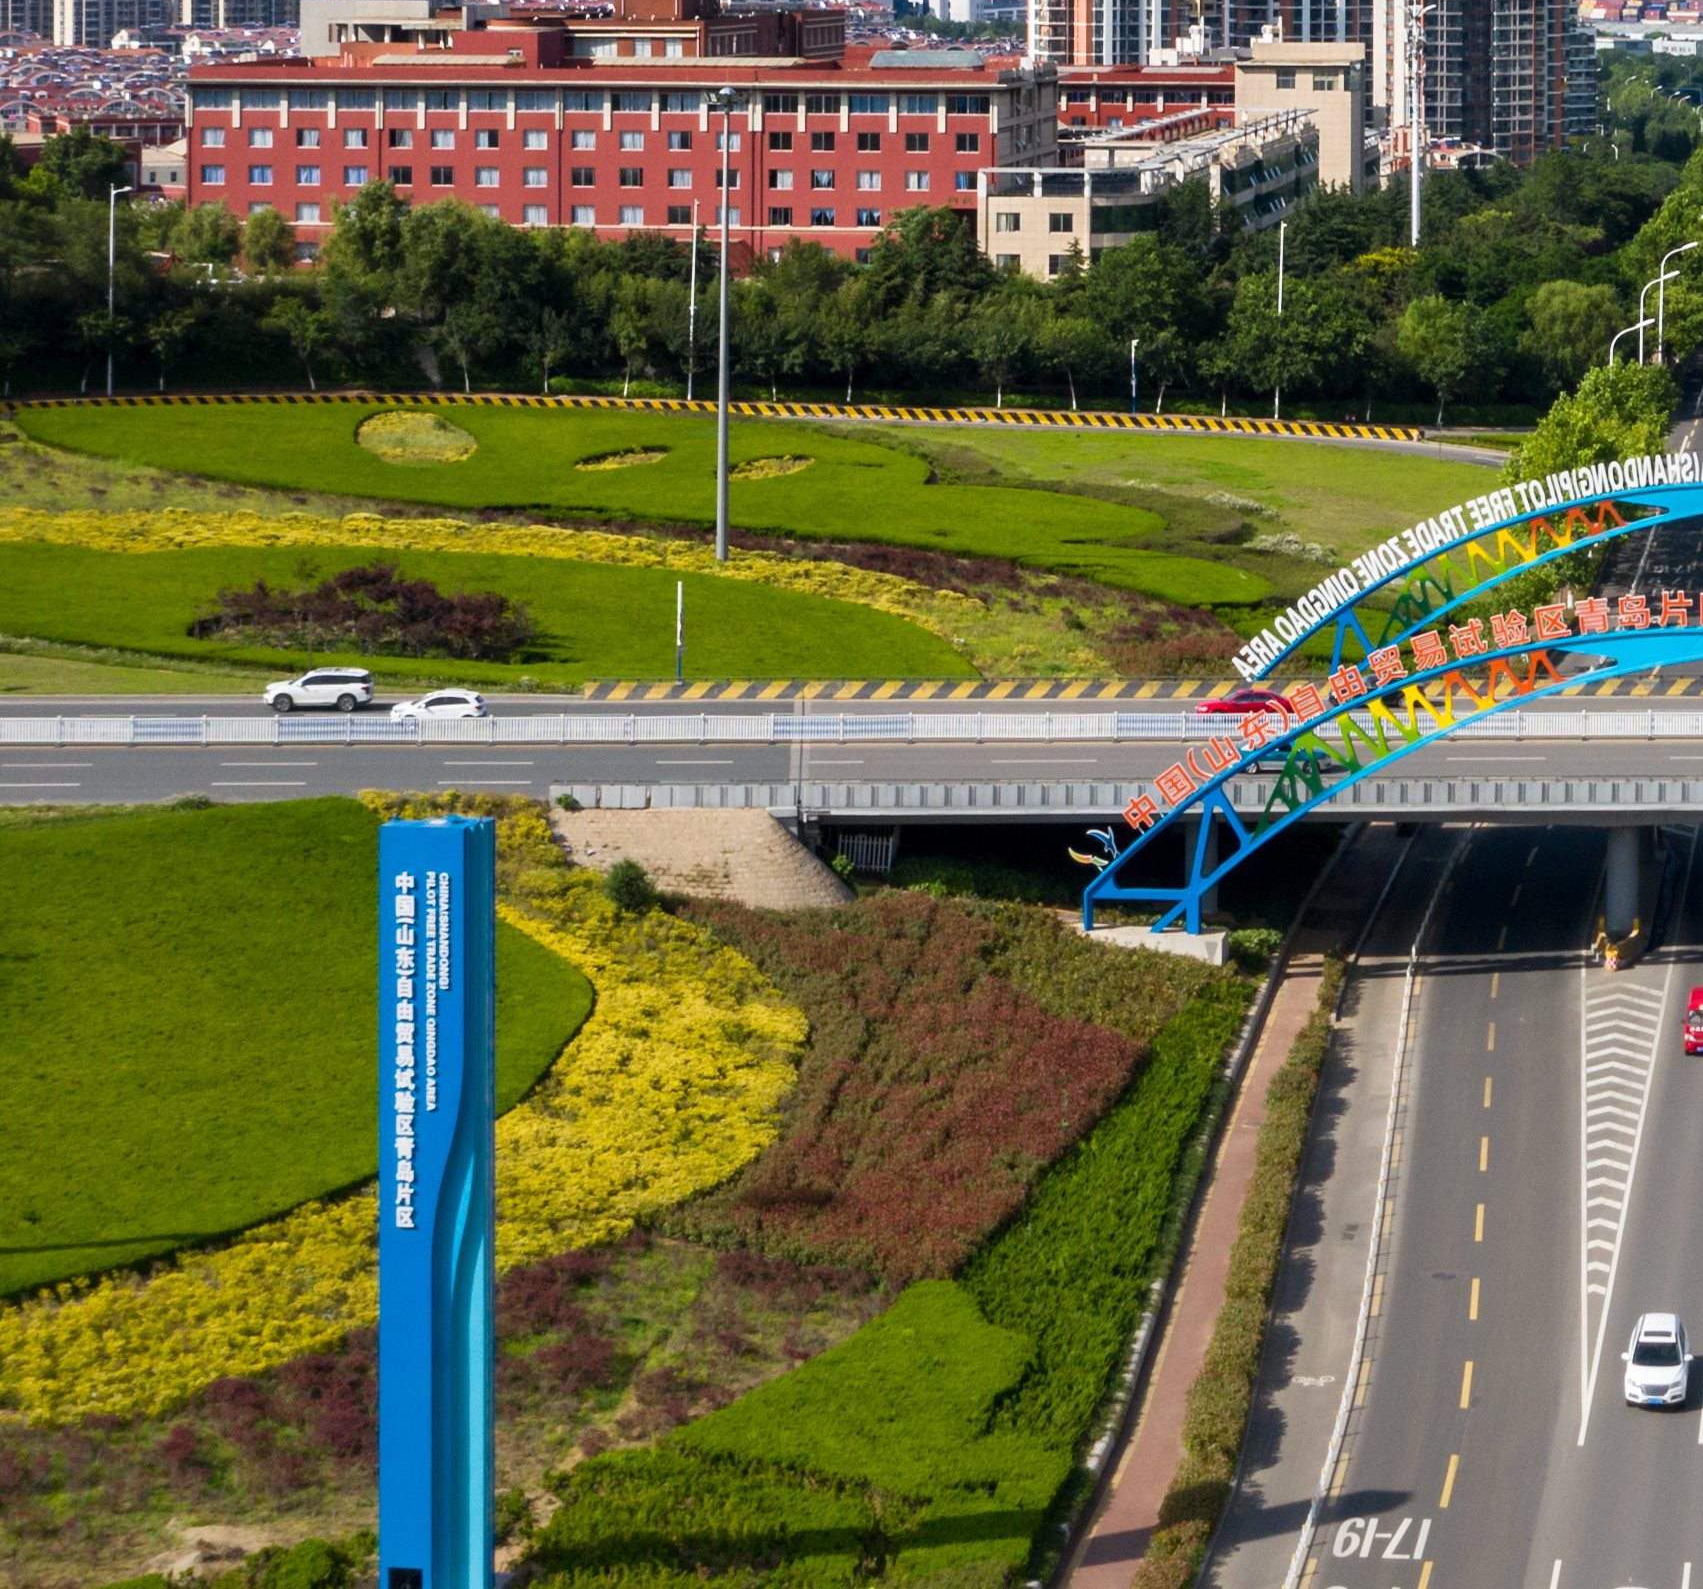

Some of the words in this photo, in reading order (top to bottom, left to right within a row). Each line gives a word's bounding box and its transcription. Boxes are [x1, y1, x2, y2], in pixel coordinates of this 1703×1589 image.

[426, 871, 436, 907] PILOT
[426, 908, 436, 938] FREE
[426, 940, 436, 980] TRADE
[426, 982, 436, 1016] ZONE
[426, 1017, 436, 1076] QINGDAO
[426, 1077, 436, 1111] AREA
[1332, 1517, 1432, 1560] 17-19
